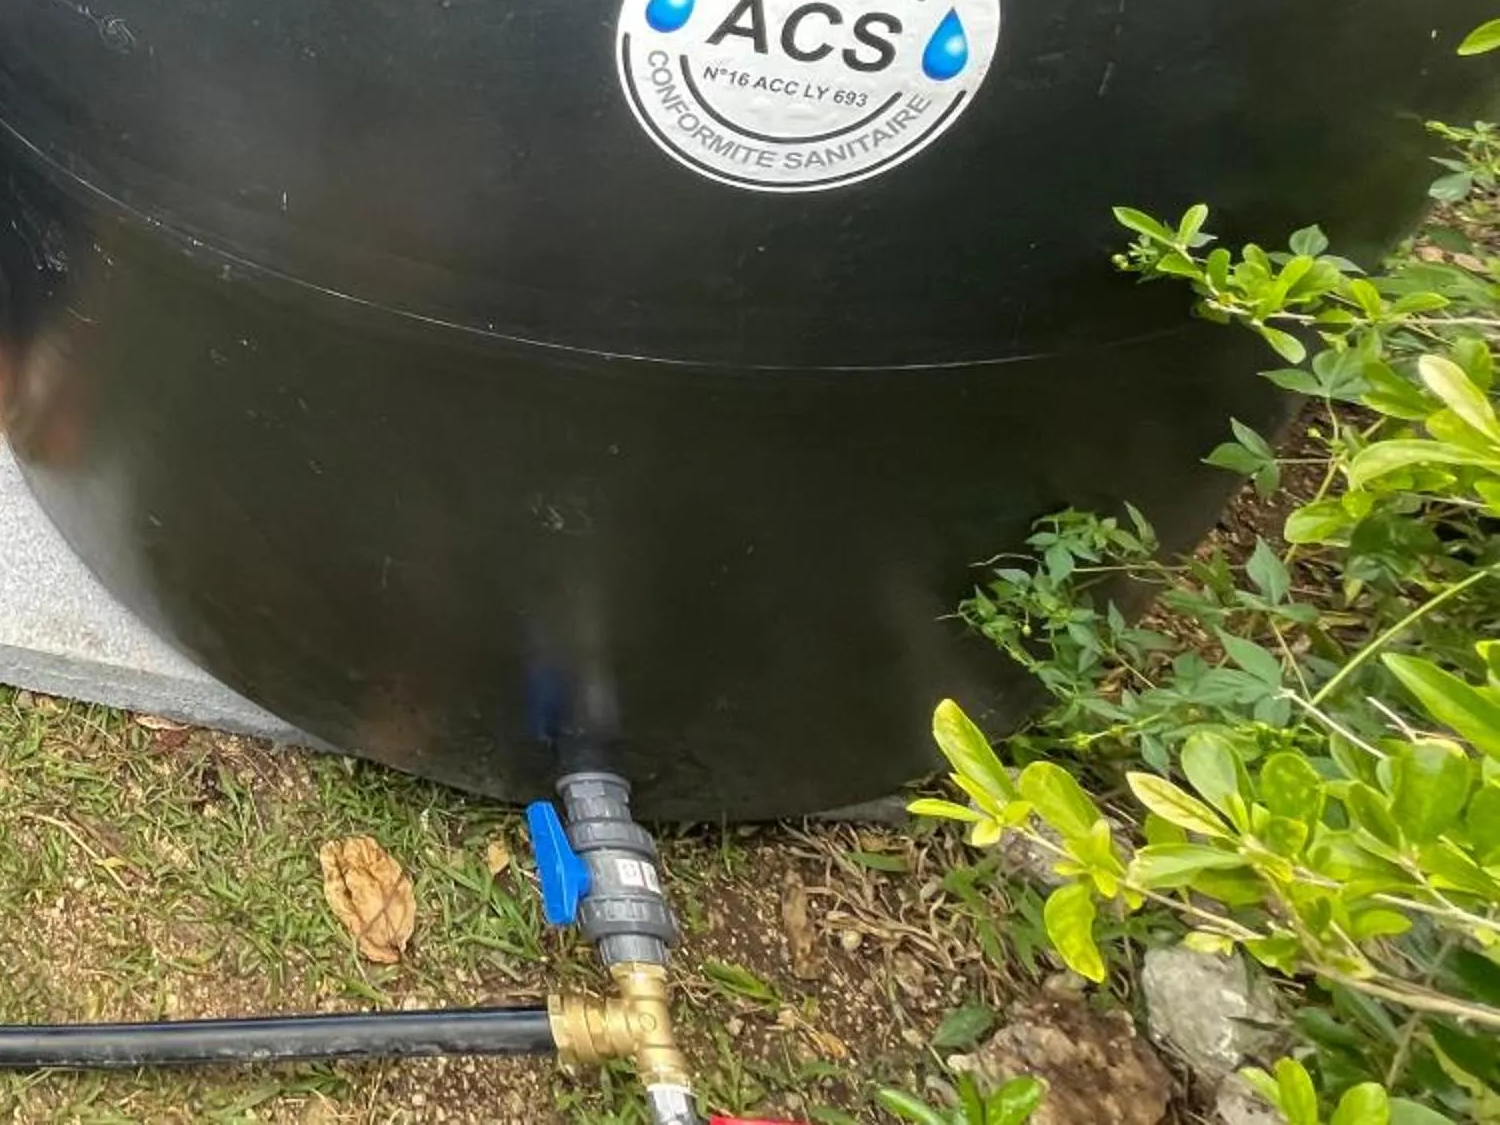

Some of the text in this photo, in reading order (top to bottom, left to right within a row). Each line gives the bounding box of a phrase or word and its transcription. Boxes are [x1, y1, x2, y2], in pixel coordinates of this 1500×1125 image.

[647, 50, 933, 170] CONFORMITE SANITAIRE
[752, 77, 799, 97] ACC
[803, 83, 830, 101] LY
[833, 88, 869, 108] 693
